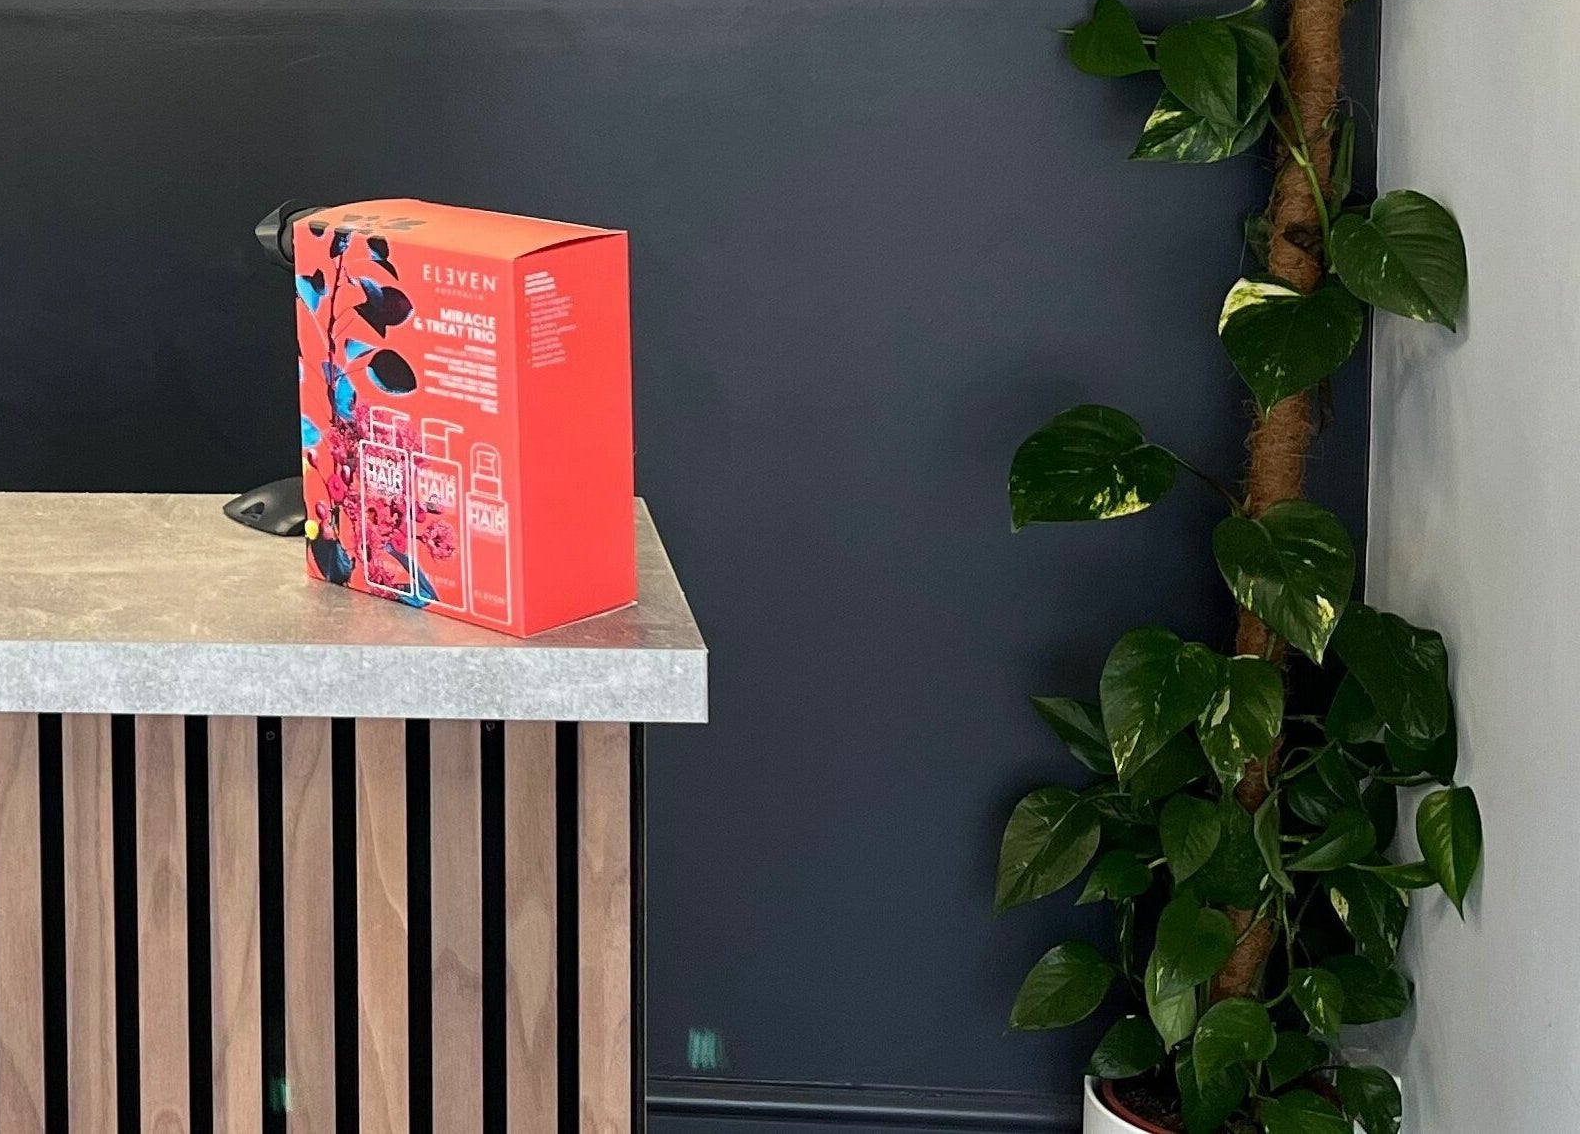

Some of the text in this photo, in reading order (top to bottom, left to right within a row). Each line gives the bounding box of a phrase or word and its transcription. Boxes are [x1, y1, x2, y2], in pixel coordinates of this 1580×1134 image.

[412, 316, 497, 345] & TREAT TRIO
[440, 307, 496, 331] MIRACLE
[365, 463, 402, 490] HAIR
[417, 475, 456, 504] HAIR
[467, 505, 506, 533] HAIR
